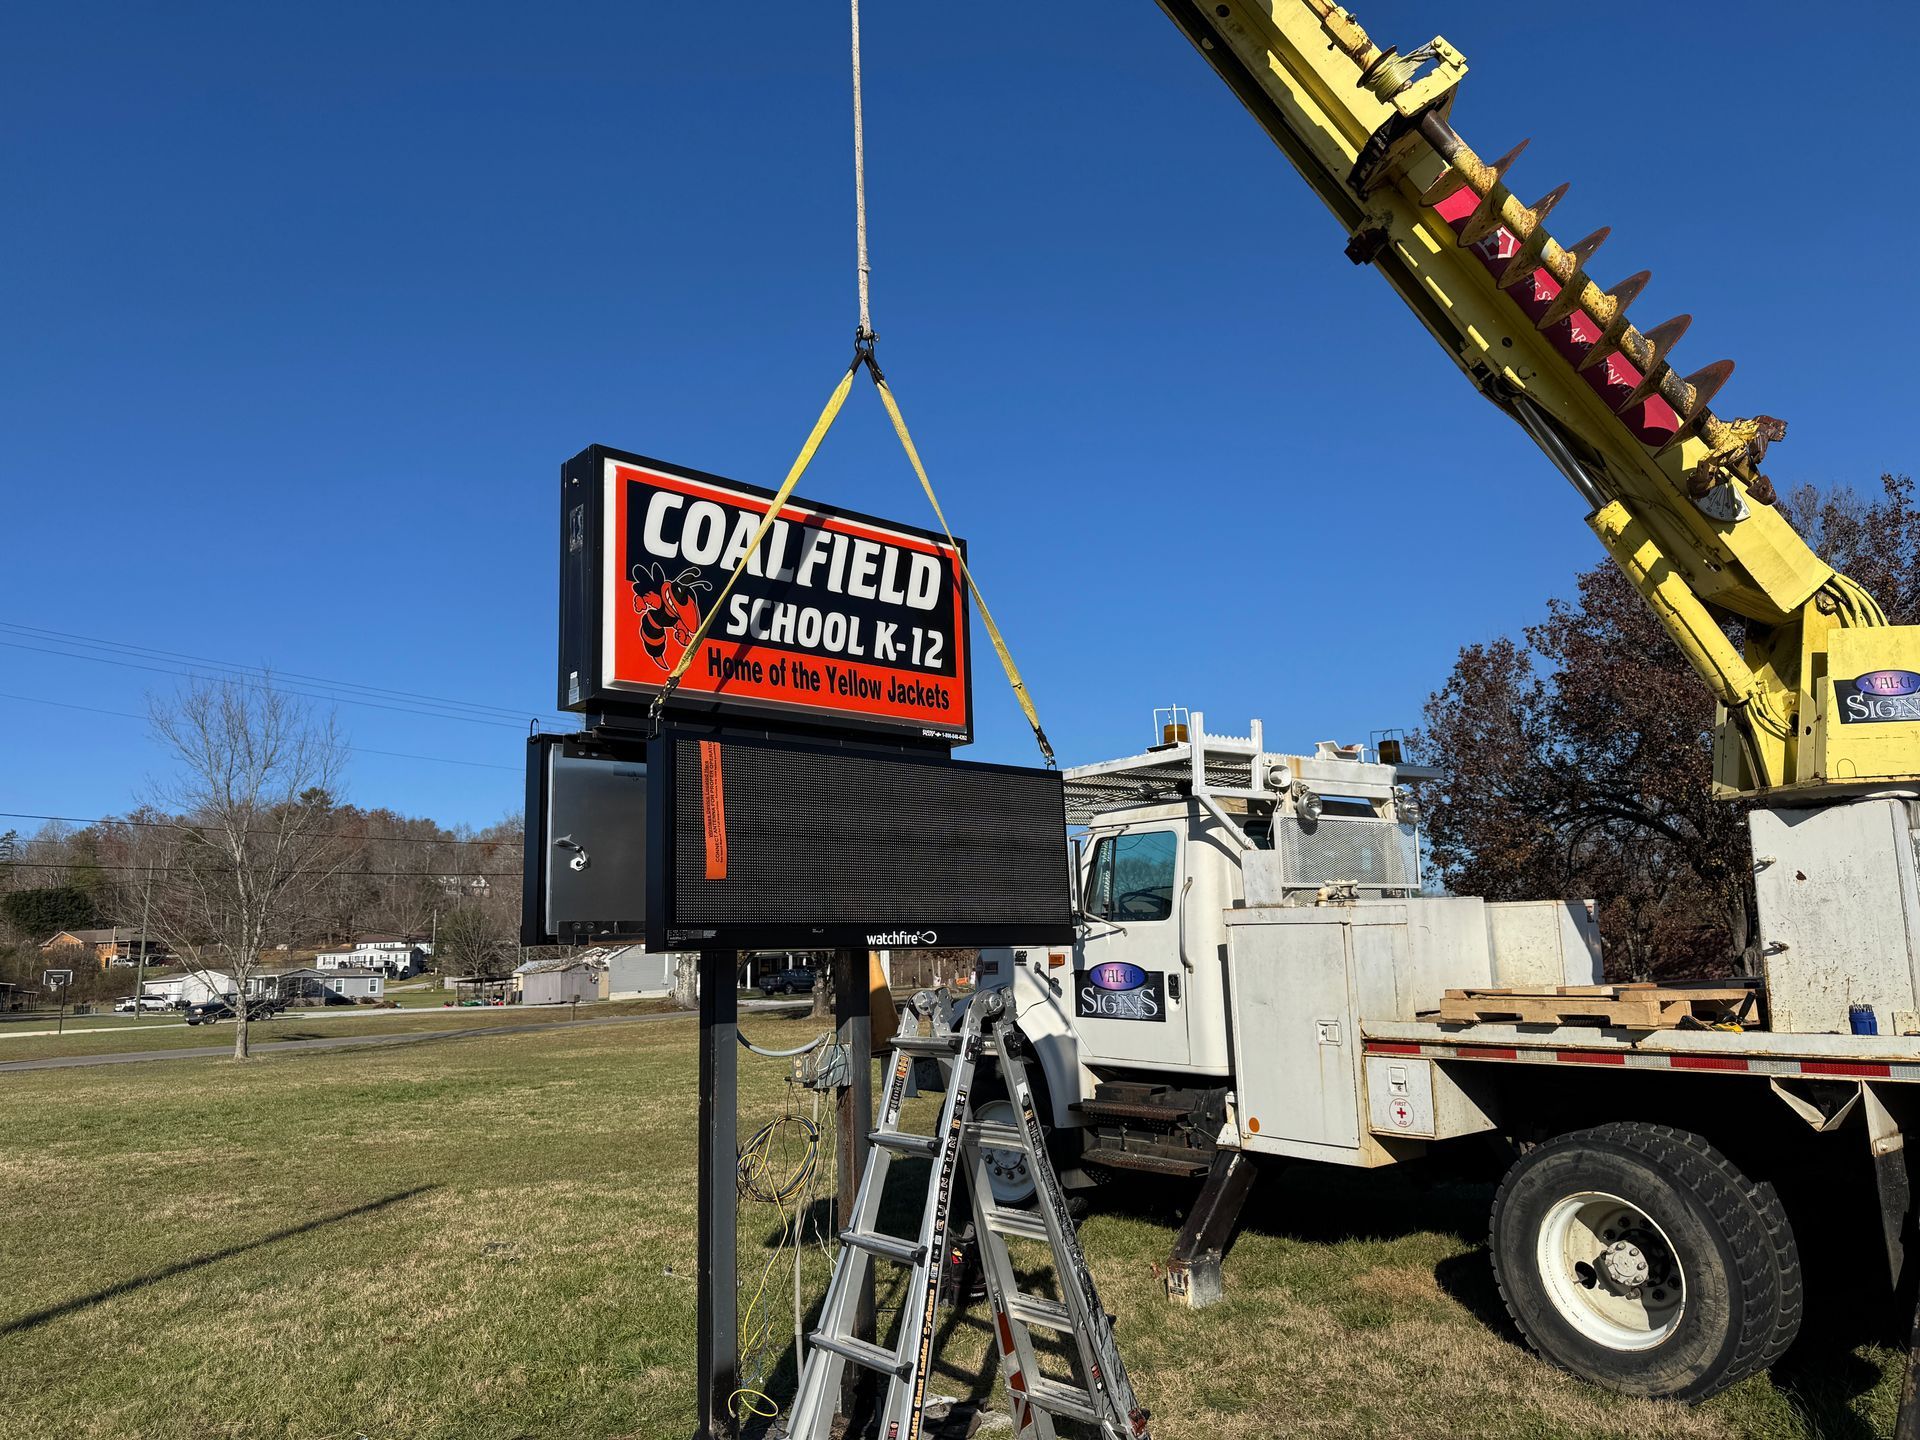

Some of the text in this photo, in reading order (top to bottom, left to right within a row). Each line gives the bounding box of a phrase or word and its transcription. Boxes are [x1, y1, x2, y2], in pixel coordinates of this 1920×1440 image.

[643, 491, 942, 611] COALFIELD
[726, 593, 944, 669] SCHOOL K-12
[707, 647, 950, 711] Home of the Yellow Jackets
[1846, 689, 1920, 722] SIGN
[866, 930, 918, 945] watchfire
[1081, 986, 1158, 1018] SIGNS
[923, 1289, 935, 1335] Systems
[918, 1337, 929, 1376] Ladder
[914, 1379, 924, 1408] Giant
